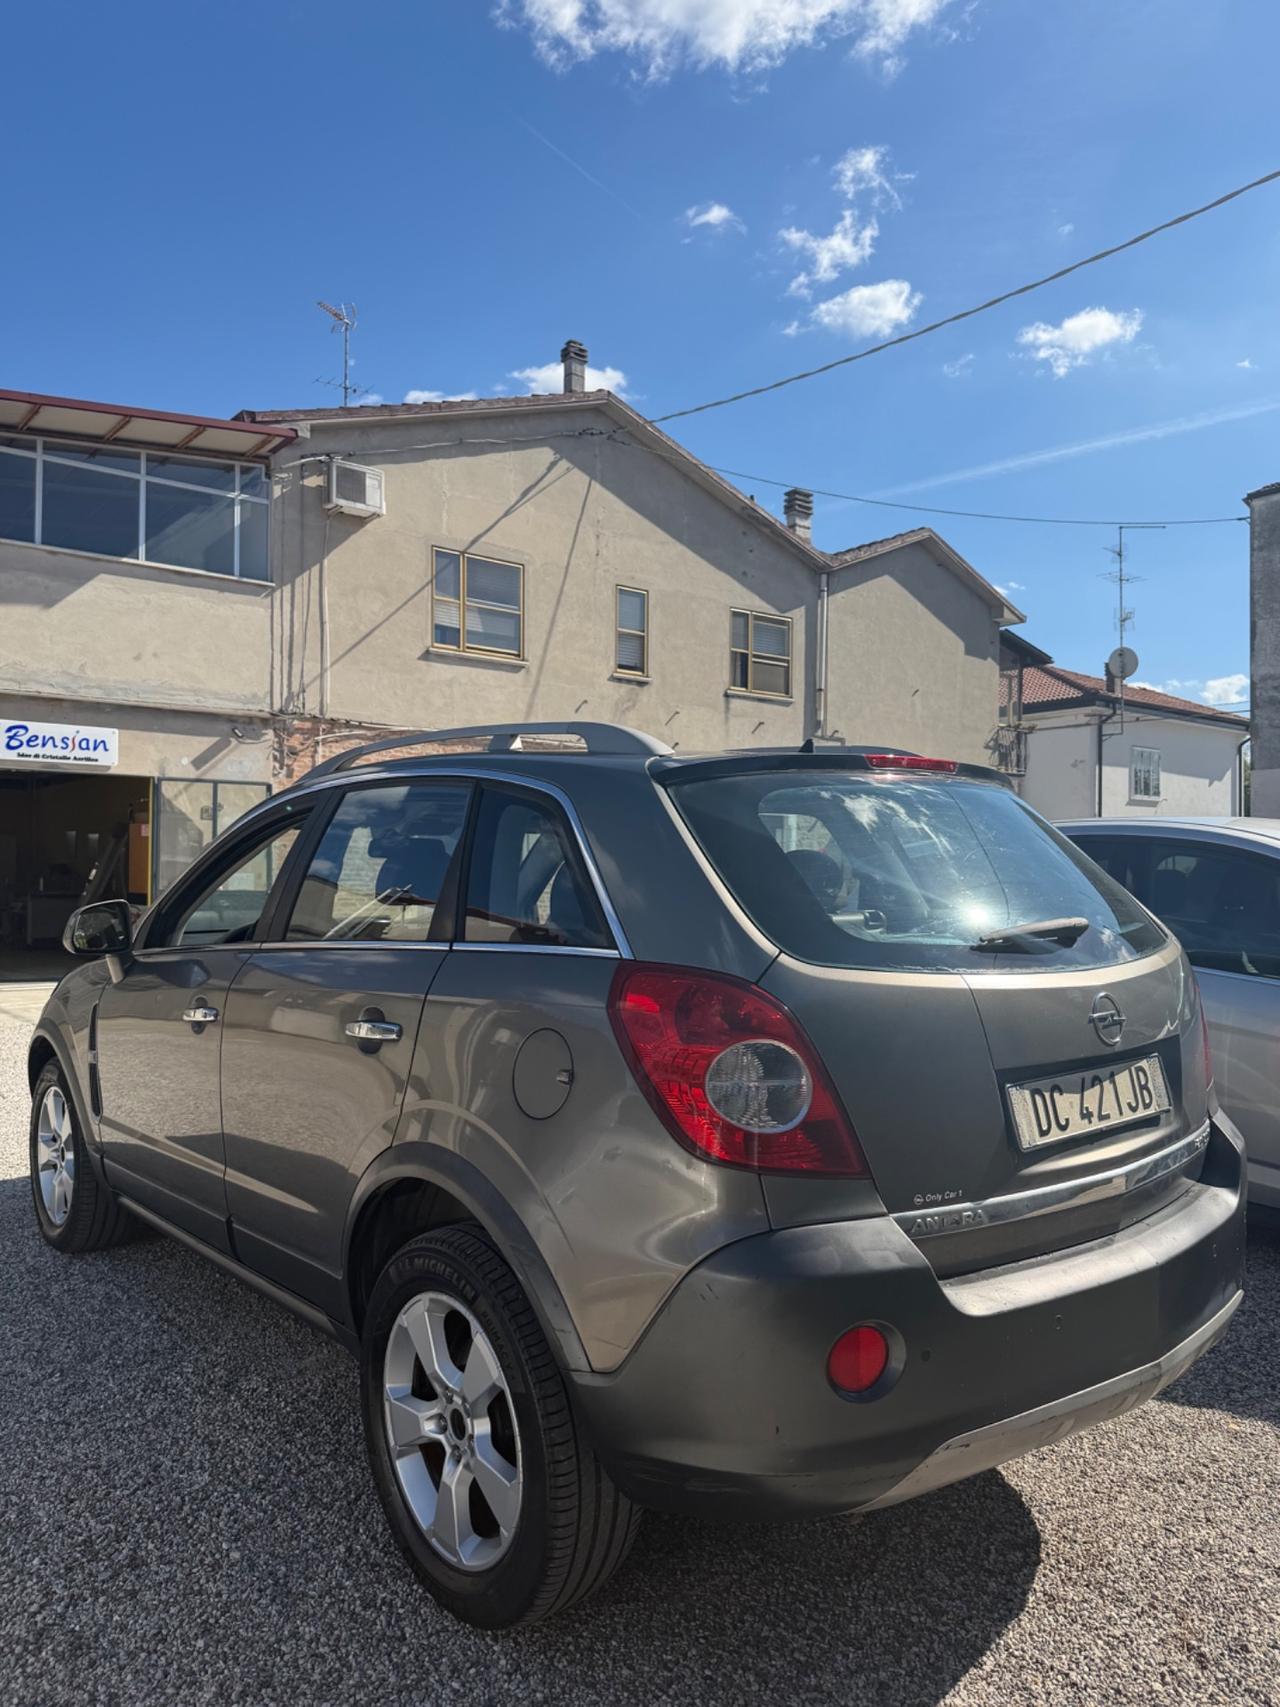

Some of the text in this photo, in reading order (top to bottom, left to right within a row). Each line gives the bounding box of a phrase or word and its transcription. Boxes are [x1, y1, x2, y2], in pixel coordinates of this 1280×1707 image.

[5, 724, 109, 752] Bensian
[1030, 1084, 1069, 1137] DC
[925, 1193, 942, 1202] Only
[944, 1190, 957, 1199] Car
[413, 1256, 477, 1301] MICHELIN
